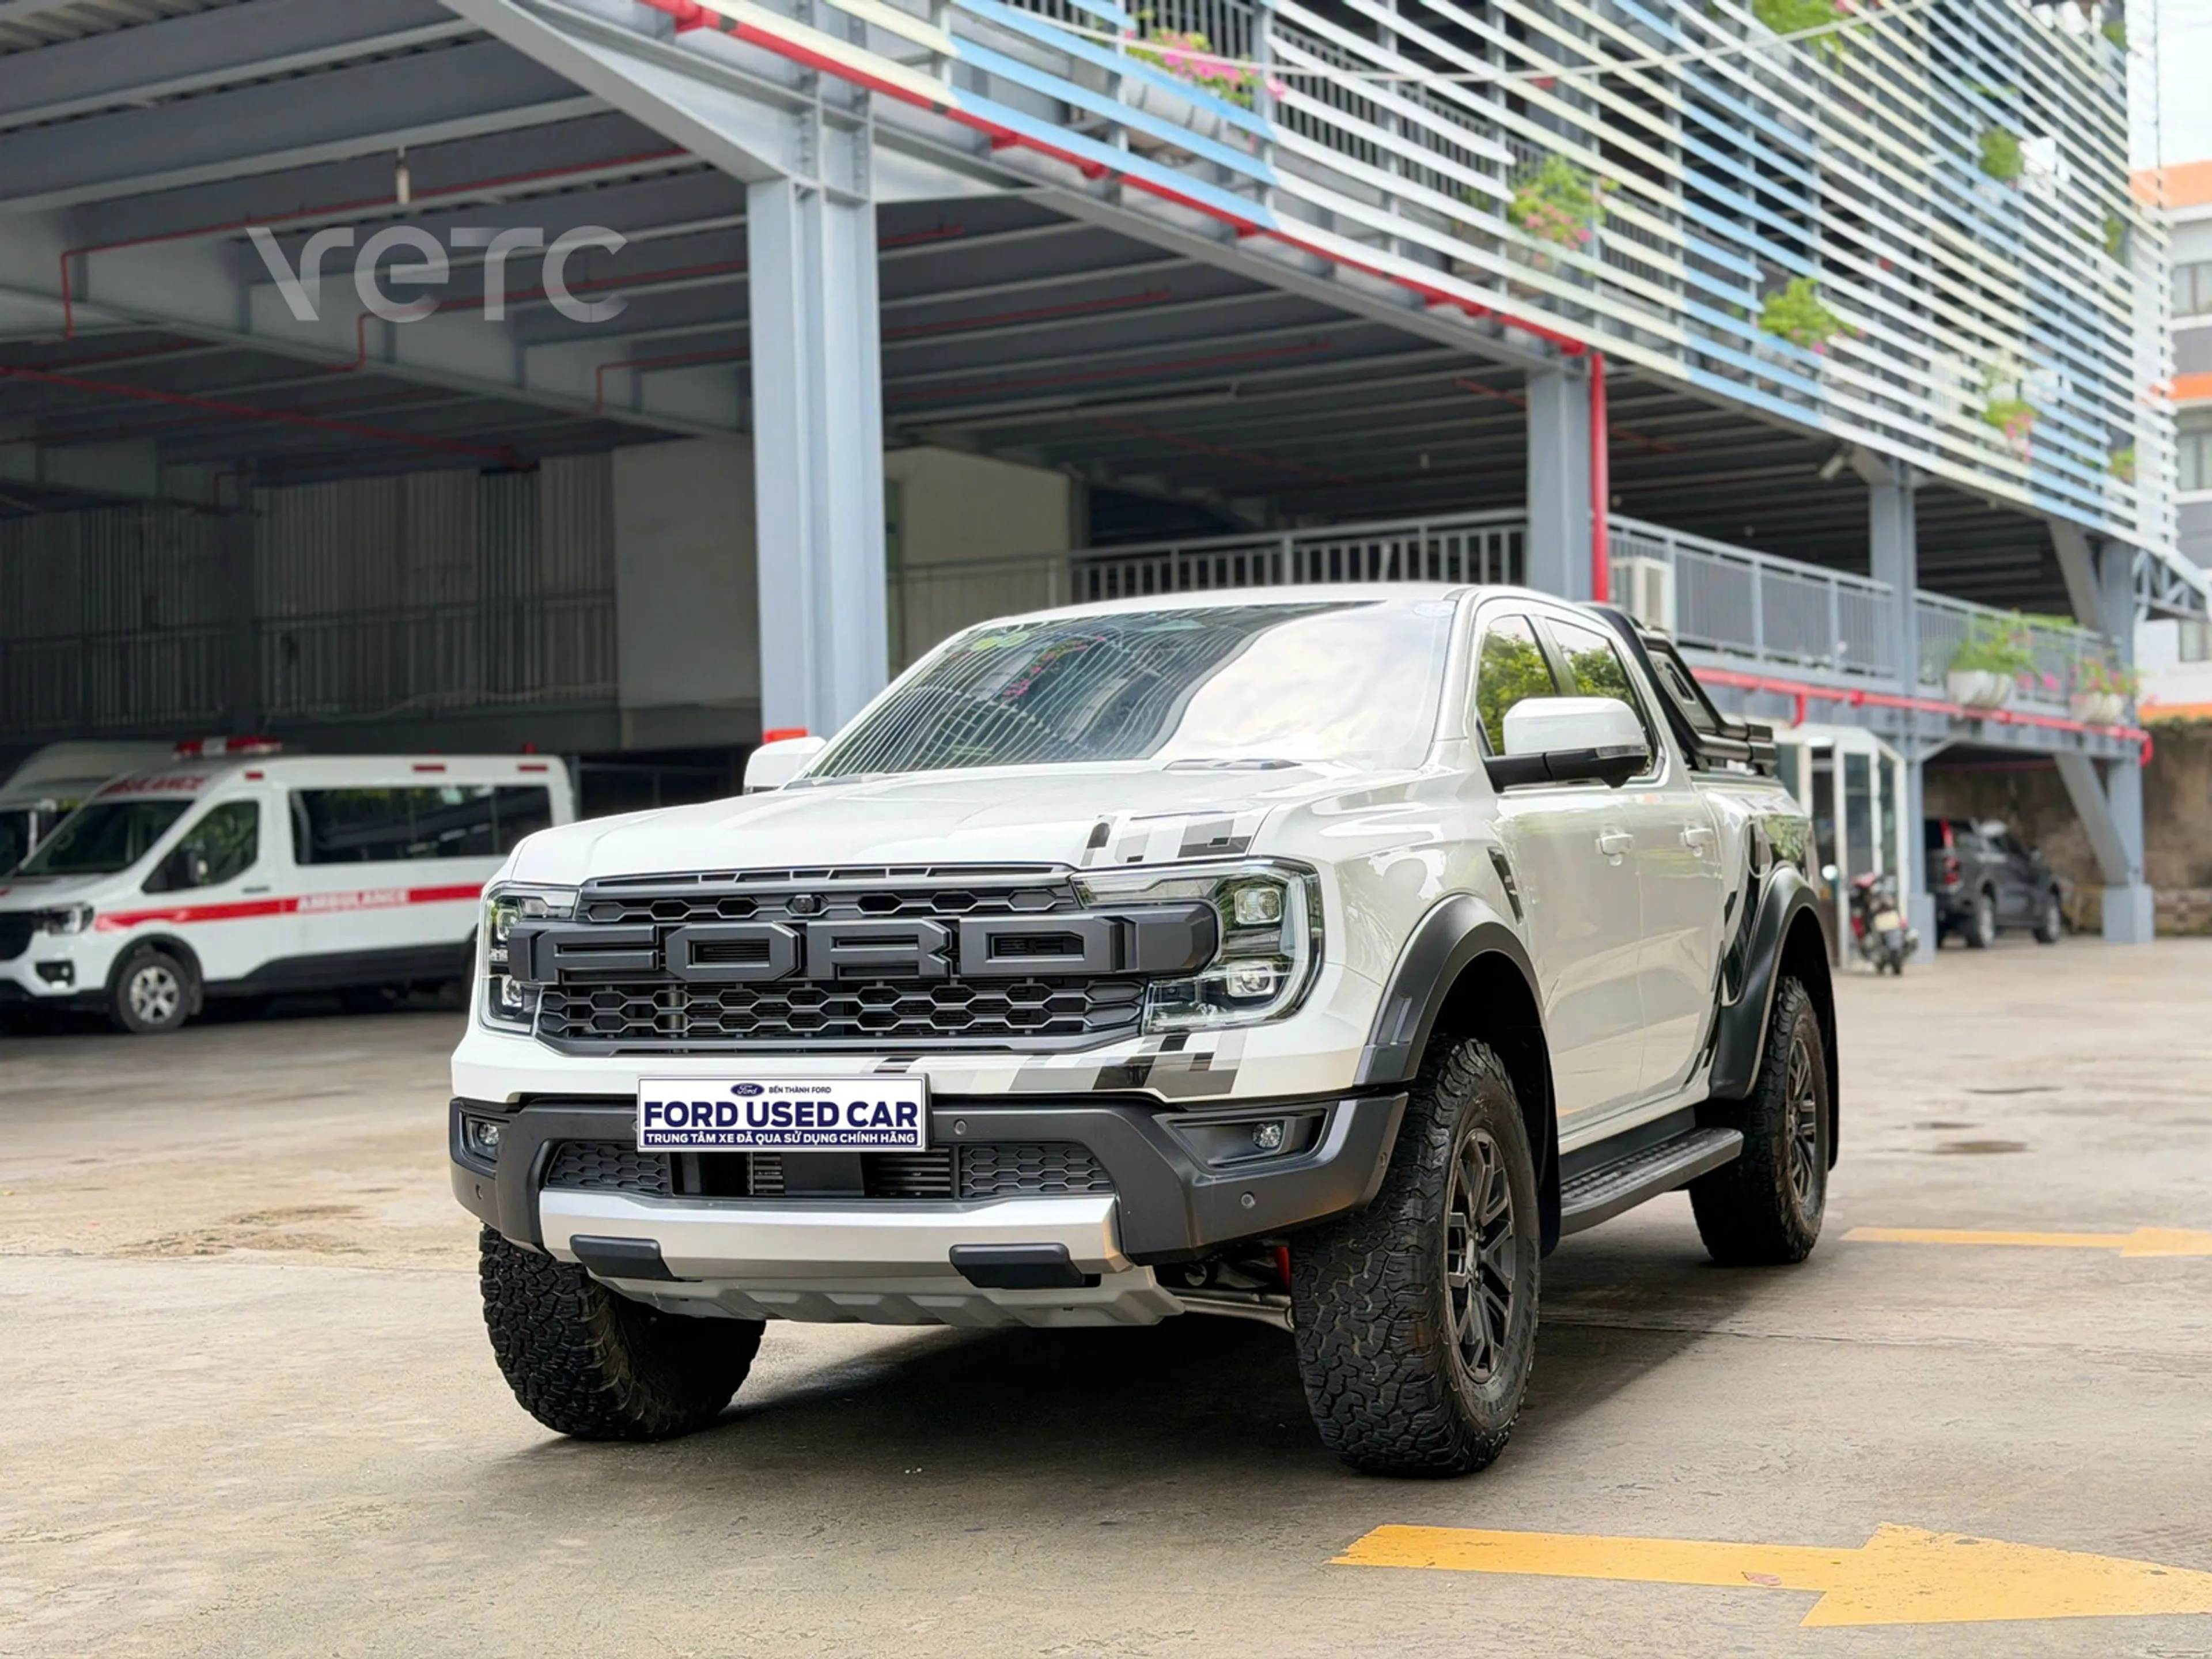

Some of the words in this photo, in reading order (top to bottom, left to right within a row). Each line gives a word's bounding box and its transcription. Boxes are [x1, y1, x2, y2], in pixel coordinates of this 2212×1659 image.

[531, 917, 1138, 984] FORD
[644, 1101, 738, 1127] FORD
[747, 1101, 839, 1127] USED
[846, 1101, 918, 1127] CAR
[646, 1134, 688, 1143] TRUNG
[691, 1131, 716, 1143] TÂM
[719, 1134, 734, 1143] XE
[736, 1131, 753, 1143] ĐÃ
[755, 1133, 782, 1145] QUA
[783, 1131, 802, 1143] SỬ
[803, 1133, 838, 1146] DỤNG
[839, 1131, 878, 1143] CHÍNH
[880, 1131, 915, 1143] HÃNG
